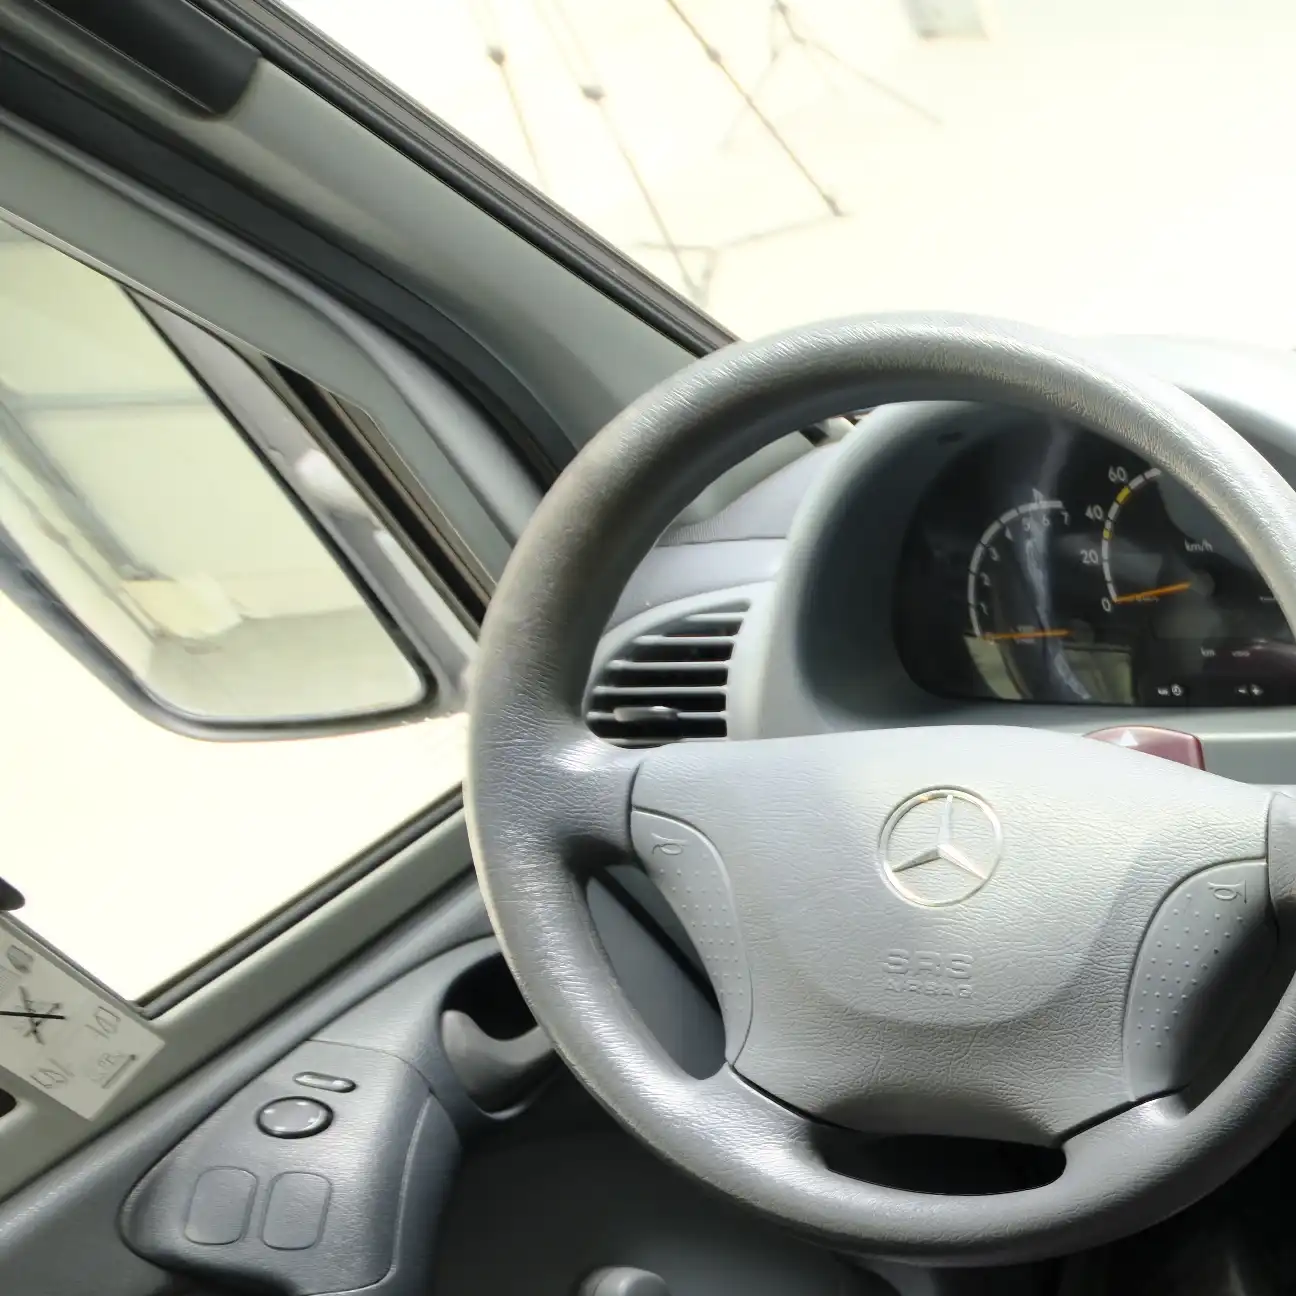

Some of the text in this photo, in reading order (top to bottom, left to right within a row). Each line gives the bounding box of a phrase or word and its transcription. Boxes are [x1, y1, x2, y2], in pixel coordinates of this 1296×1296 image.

[1108, 467, 1127, 483] 60
[1060, 511, 1070, 526] 7
[1085, 506, 1104, 521] 40
[988, 546, 1001, 562] 3
[1184, 540, 1214, 553] km/h
[1080, 550, 1099, 565] 20
[1101, 598, 1112, 613] 0
[884, 948, 975, 979] SRS
[886, 978, 974, 999] AIRBAG
